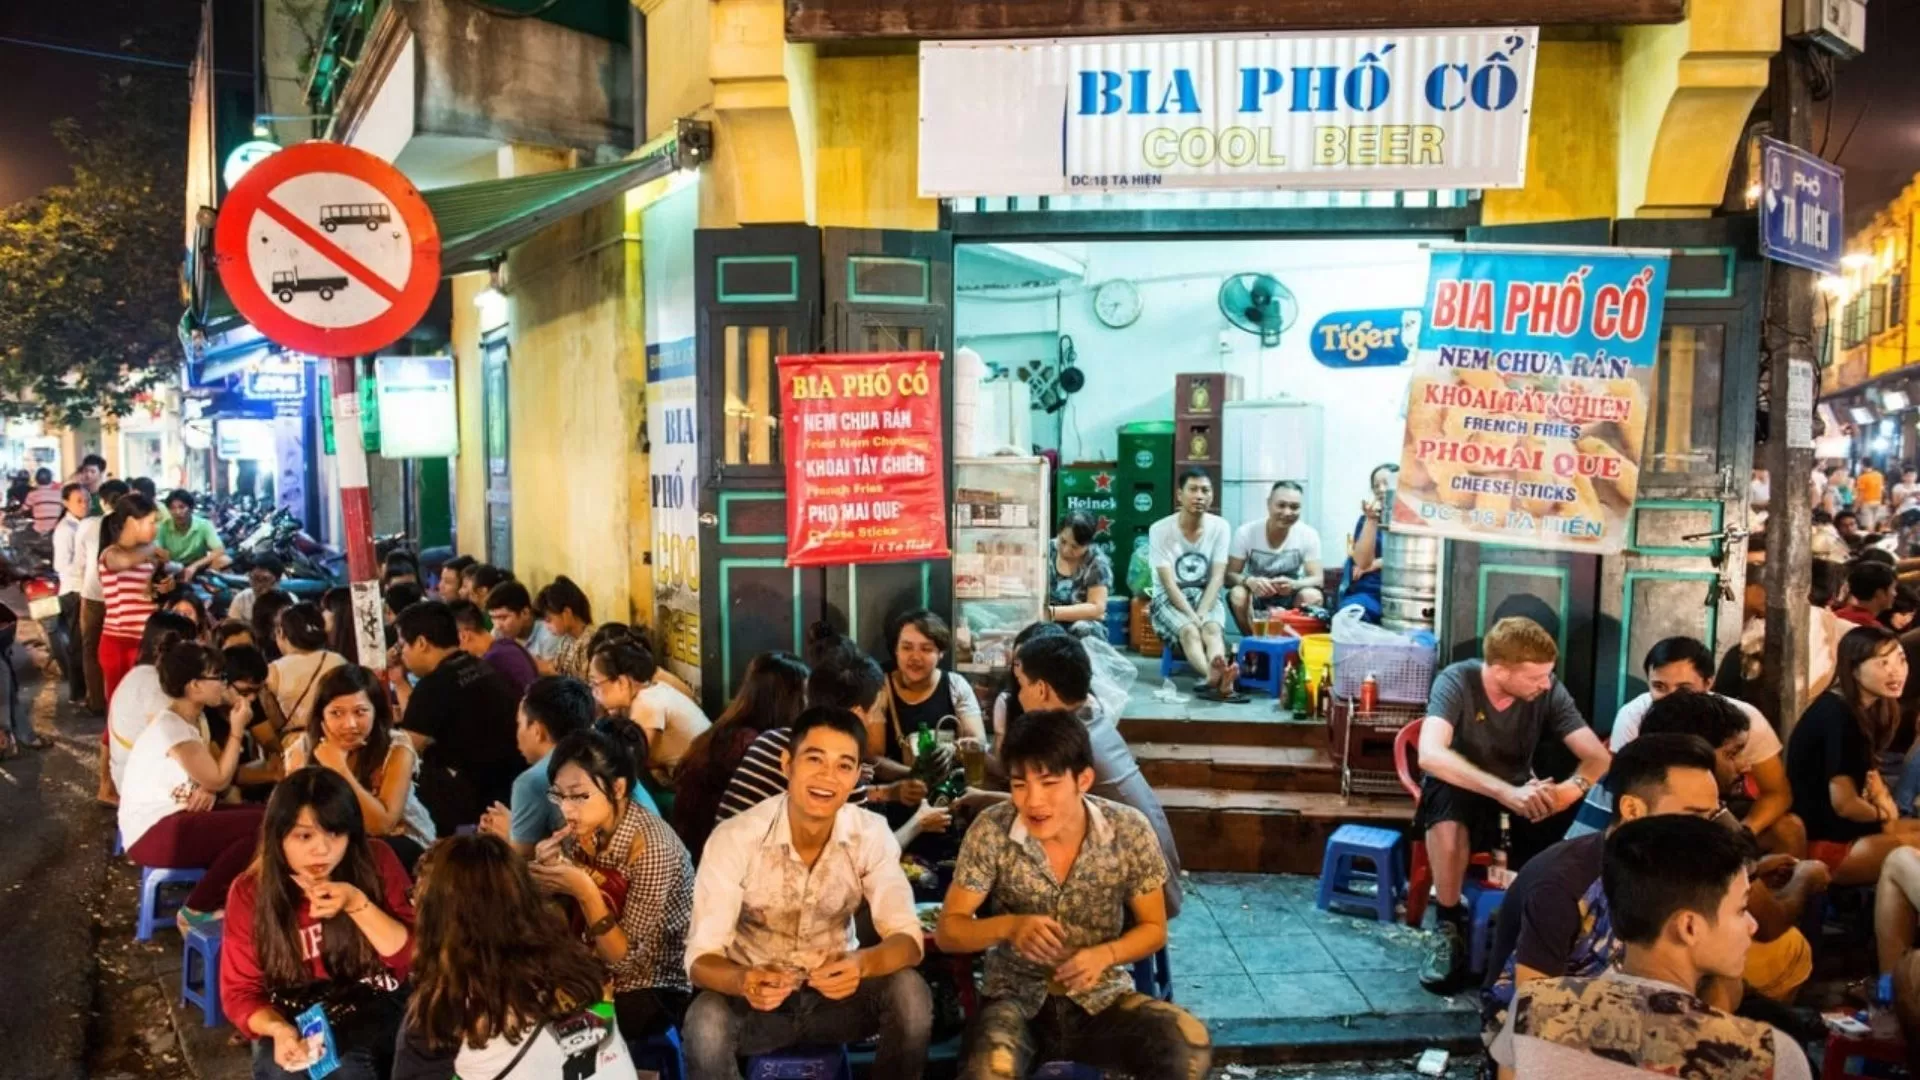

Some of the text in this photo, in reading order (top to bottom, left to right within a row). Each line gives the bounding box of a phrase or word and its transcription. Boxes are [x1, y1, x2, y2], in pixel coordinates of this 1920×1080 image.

[1077, 35, 1525, 115] BIA PHỐ CỔ
[1141, 125, 1446, 168] COOL BEER
[1432, 264, 1656, 342] BIA PHỐ CỔ
[1318, 320, 1400, 361] Tiger
[1439, 346, 1630, 379] NEM CHUA RÁN
[792, 374, 837, 400] BIA
[842, 363, 892, 398] PHỐ
[1423, 383, 1499, 411] KHOAI
[663, 407, 695, 445] BIA
[804, 407, 913, 433] NEM CHUA RÁN
[1463, 415, 1582, 440] FRENCH FRIES
[806, 457, 850, 478] KHOAI
[853, 453, 878, 477] TÂY
[1552, 452, 1622, 479] QUE
[651, 458, 684, 510] PHỐ
[1450, 475, 1577, 502] CHEESE STICKS
[842, 501, 870, 522] MAI
[873, 500, 901, 521] QUE
[1066, 495, 1118, 511] Heinek
[657, 531, 700, 593] COO
